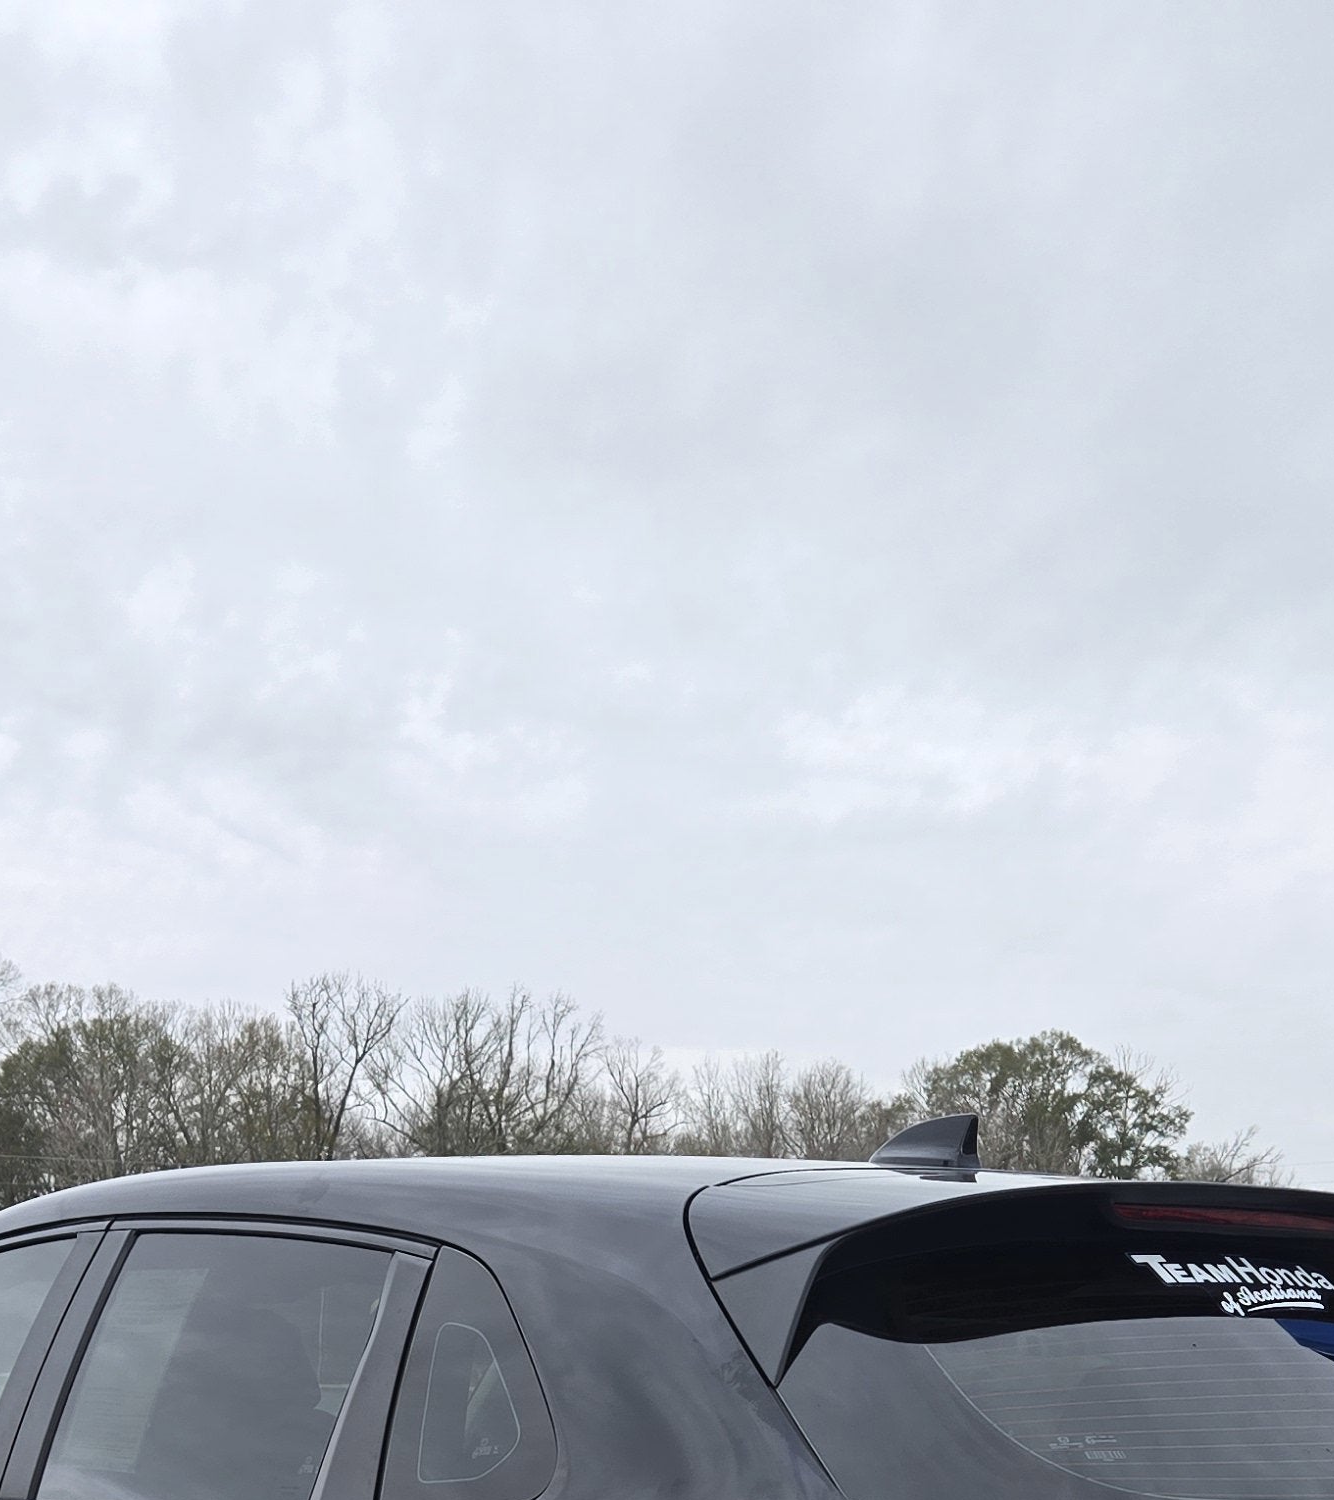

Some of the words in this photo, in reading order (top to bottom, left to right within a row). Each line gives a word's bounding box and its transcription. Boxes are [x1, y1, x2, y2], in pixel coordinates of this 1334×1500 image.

[1130, 1254, 1243, 1284] TEAM
[1221, 1291, 1245, 1316] of
[1237, 1284, 1322, 1306] Acadiana
